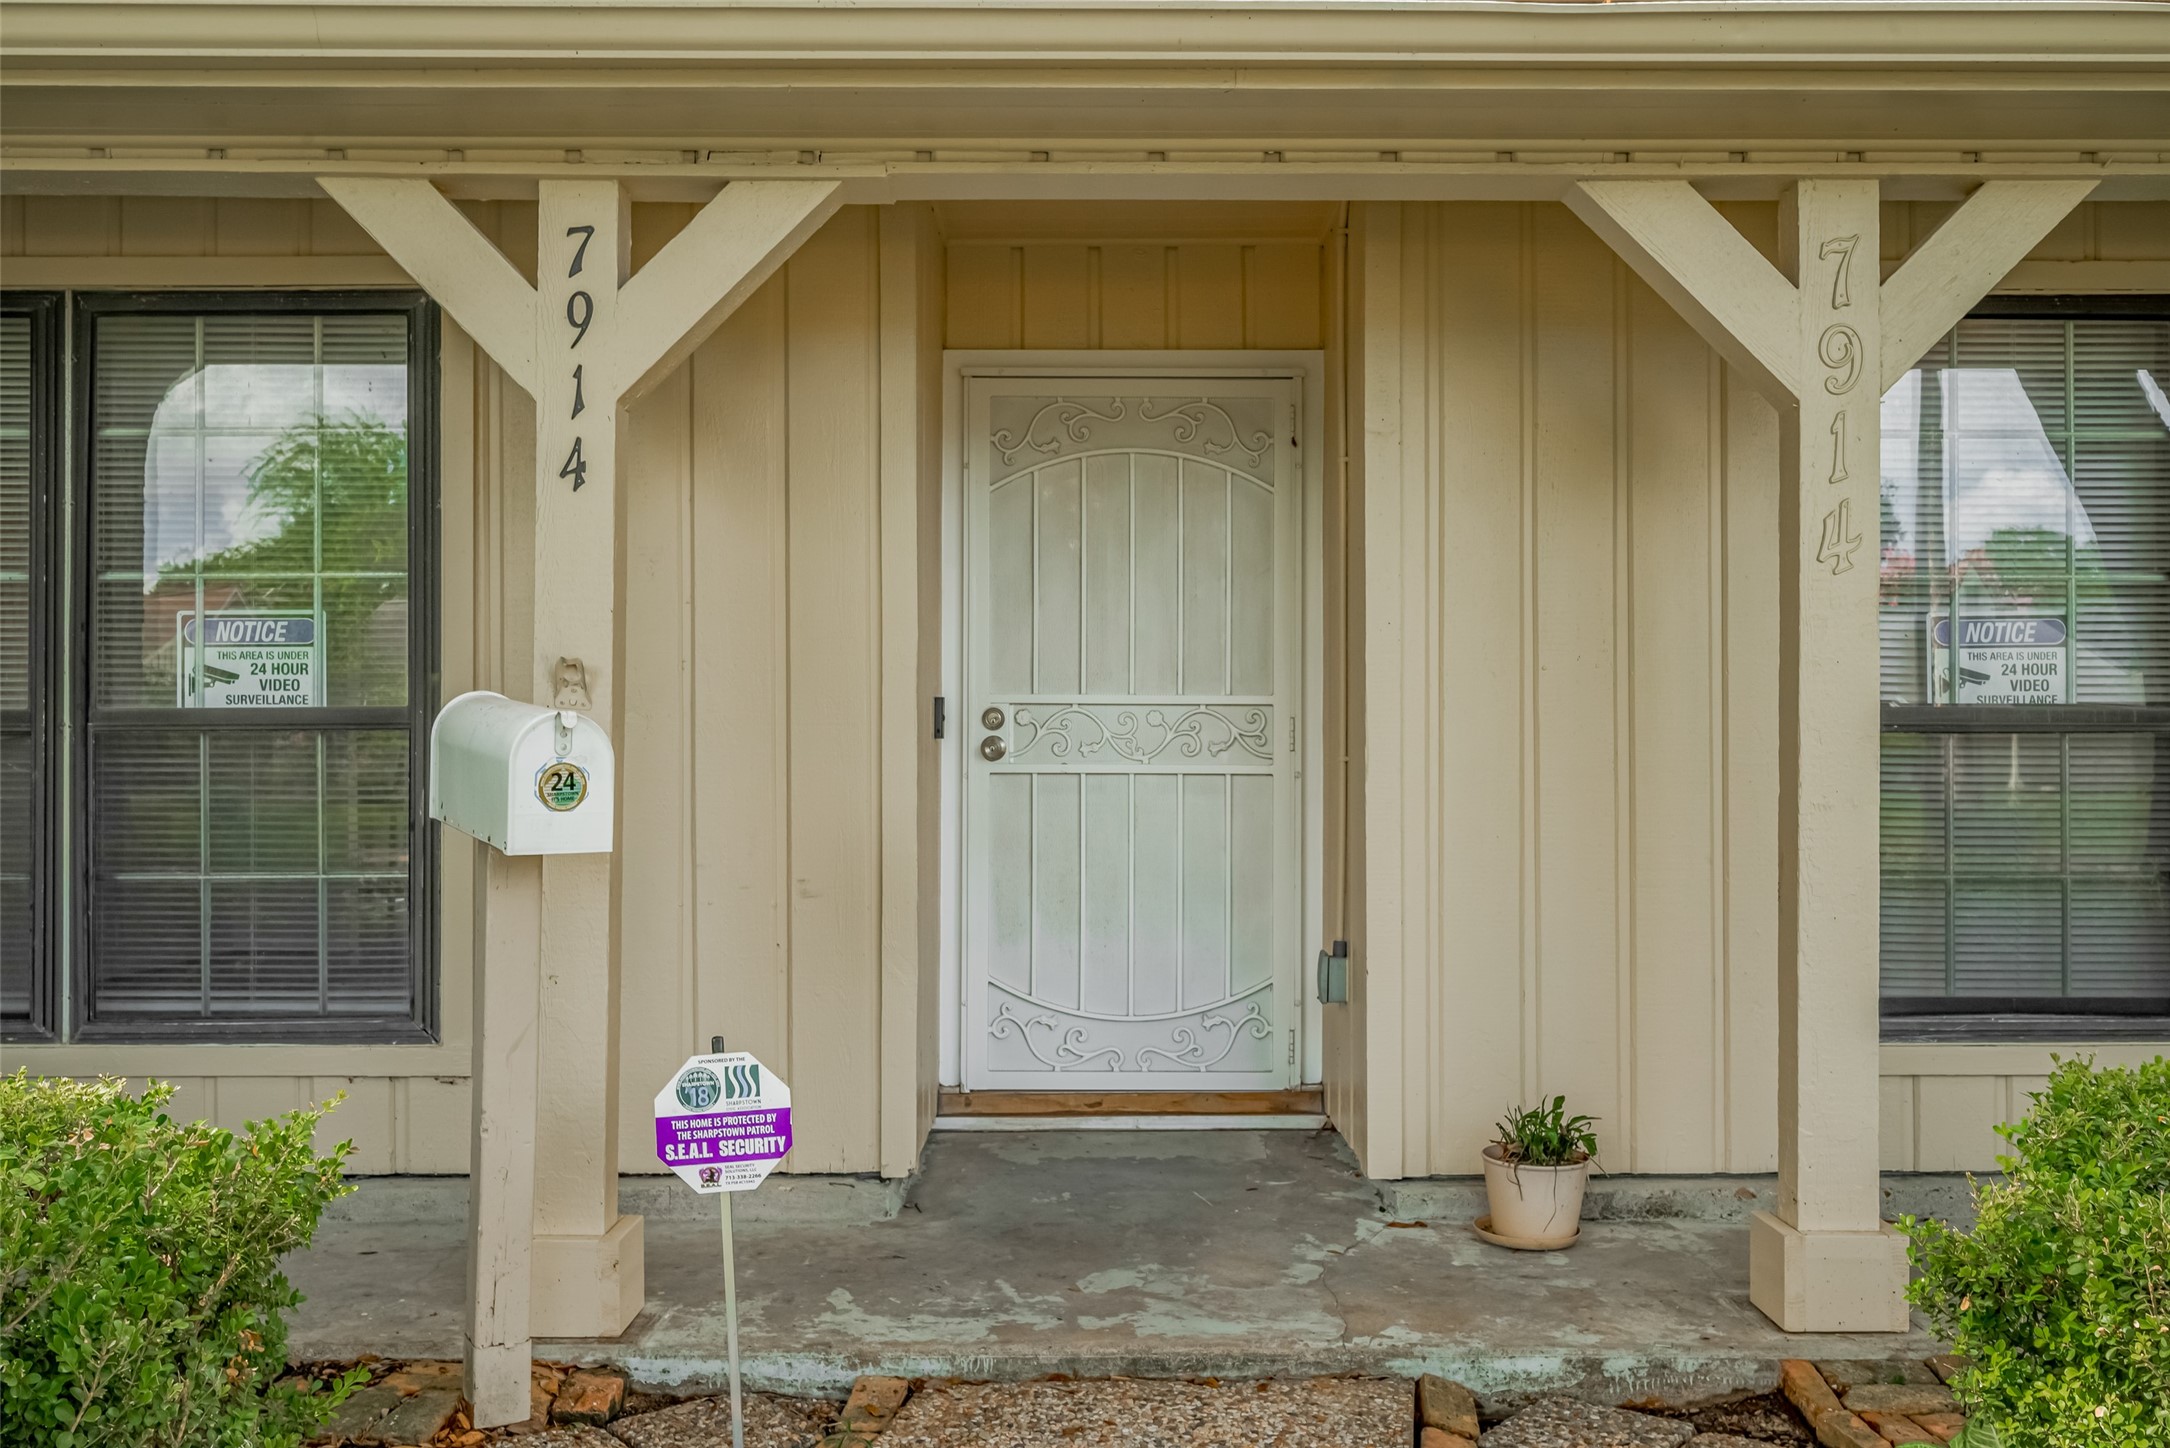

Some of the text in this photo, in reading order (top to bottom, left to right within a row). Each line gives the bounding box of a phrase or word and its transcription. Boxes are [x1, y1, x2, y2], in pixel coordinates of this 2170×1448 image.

[215, 620, 289, 642] NOTICE
[1965, 621, 2038, 643] NOTICE
[217, 651, 309, 660] THIS AREA IS UNDER
[1968, 651, 2058, 661] THIS AREA IS UNDER
[250, 662, 309, 675] 24 HOUR
[2001, 663, 2058, 676] 24 HOUR
[259, 678, 301, 692] VIDEO
[2010, 679, 2050, 692] VIDEO
[225, 694, 309, 705] SURVEILLANCE
[1976, 694, 2058, 704] SURVEILLANCE
[551, 772, 577, 792] 24
[671, 1113, 777, 1130] THIS HOME IS PROTECTED BY
[677, 1124, 775, 1141] THE SHARPSTOWN PATROL
[665, 1136, 786, 1160] S.E.A.L. SECURITY
